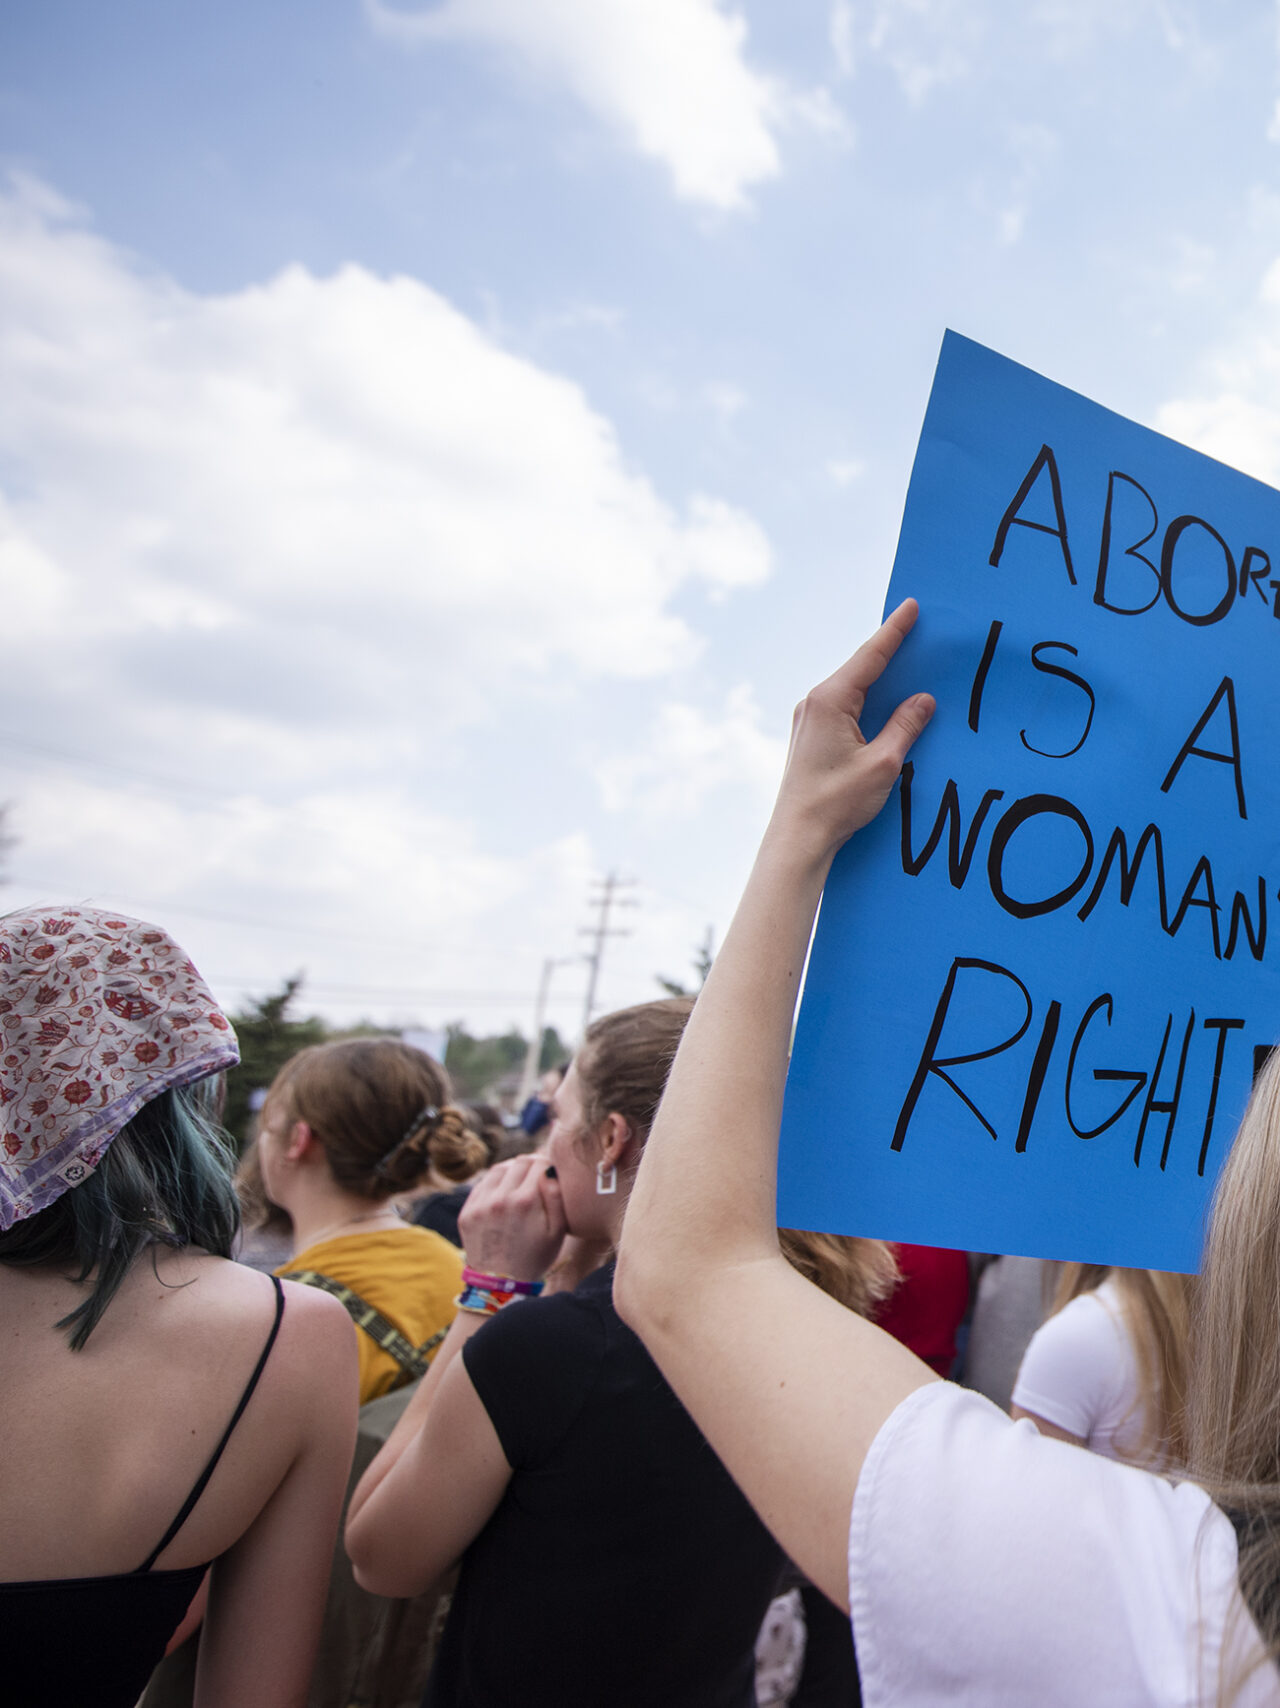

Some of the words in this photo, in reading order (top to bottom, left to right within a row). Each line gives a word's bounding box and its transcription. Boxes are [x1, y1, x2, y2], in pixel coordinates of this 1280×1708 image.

[967, 619, 1096, 759] IS
[1159, 675, 1248, 821] A
[890, 956, 1275, 1177] RIGHT
